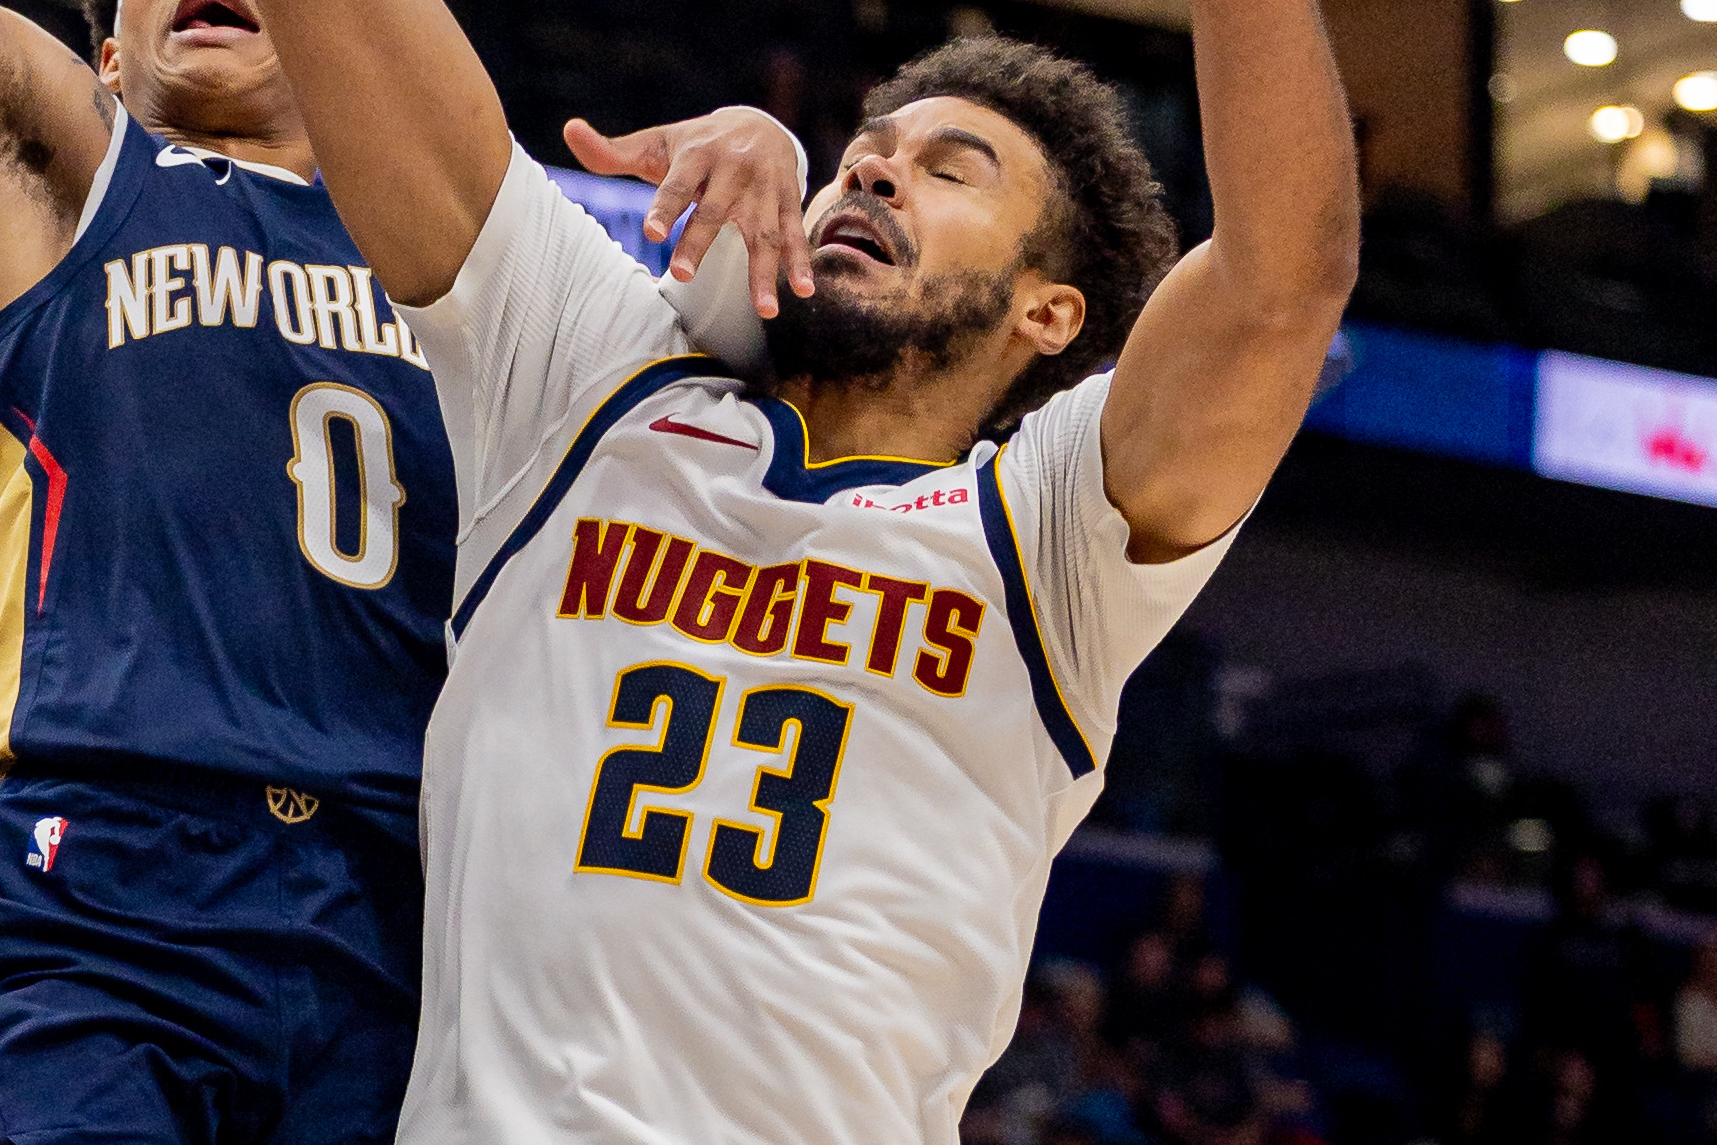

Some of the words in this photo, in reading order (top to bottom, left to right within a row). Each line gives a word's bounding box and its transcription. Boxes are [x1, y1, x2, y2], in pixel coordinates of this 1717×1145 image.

[104, 243, 263, 349] NEW
[286, 381, 406, 590] 0
[556, 517, 986, 698] NUGGETS
[574, 660, 856, 907] 23
